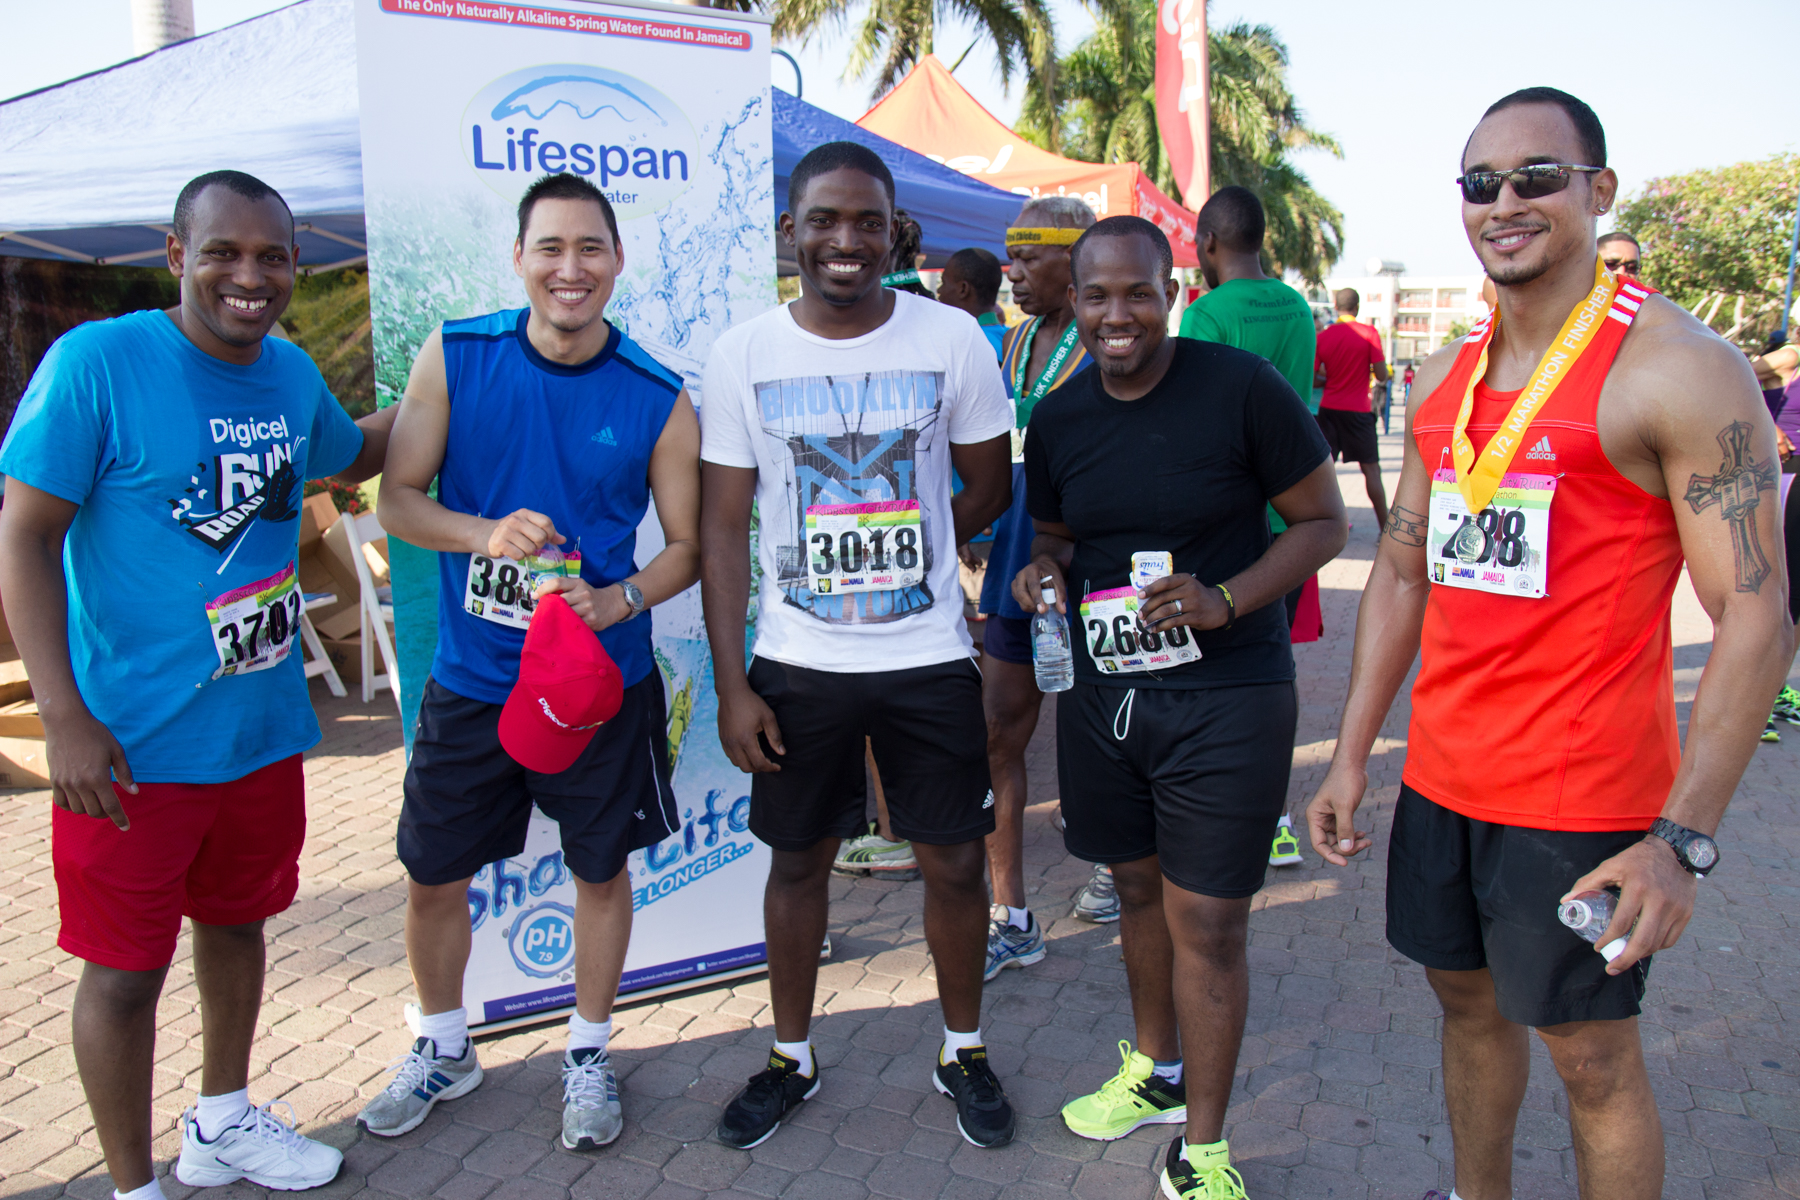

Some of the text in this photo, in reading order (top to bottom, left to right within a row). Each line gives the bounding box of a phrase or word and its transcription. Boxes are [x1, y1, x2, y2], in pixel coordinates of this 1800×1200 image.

[398, 0, 743, 46] The Only Naturally Alkaline Spring Water Found In Jamaica!
[472, 124, 689, 188] Lifespan
[602, 190, 639, 204] ater
[1033, 382, 1047, 399] 10K
[1042, 346, 1069, 384] FINISHER
[1491, 435, 1513, 459] 1/2
[1509, 351, 1568, 433] MARATHON
[1563, 285, 1610, 349] FINISHER
[759, 375, 937, 422] BROOKLYN
[209, 414, 289, 448] Digicel
[591, 435, 617, 446] adidas
[1526, 451, 1556, 461] adidas
[214, 442, 292, 511] RUN
[1519, 477, 1545, 490] Run
[815, 502, 911, 516] Kingston City Run
[1494, 490, 1518, 499] athon
[192, 495, 266, 541] ROAD
[811, 527, 918, 576] 3018
[871, 575, 893, 584] JAMAICA
[1481, 570, 1505, 583] JAMAICA
[212, 586, 260, 611] Kingston
[1087, 591, 1130, 604] Kingston
[218, 589, 301, 667] 3702
[653, 647, 678, 680] Portland
[646, 842, 754, 901] LONGER...
[525, 923, 568, 952] pH
